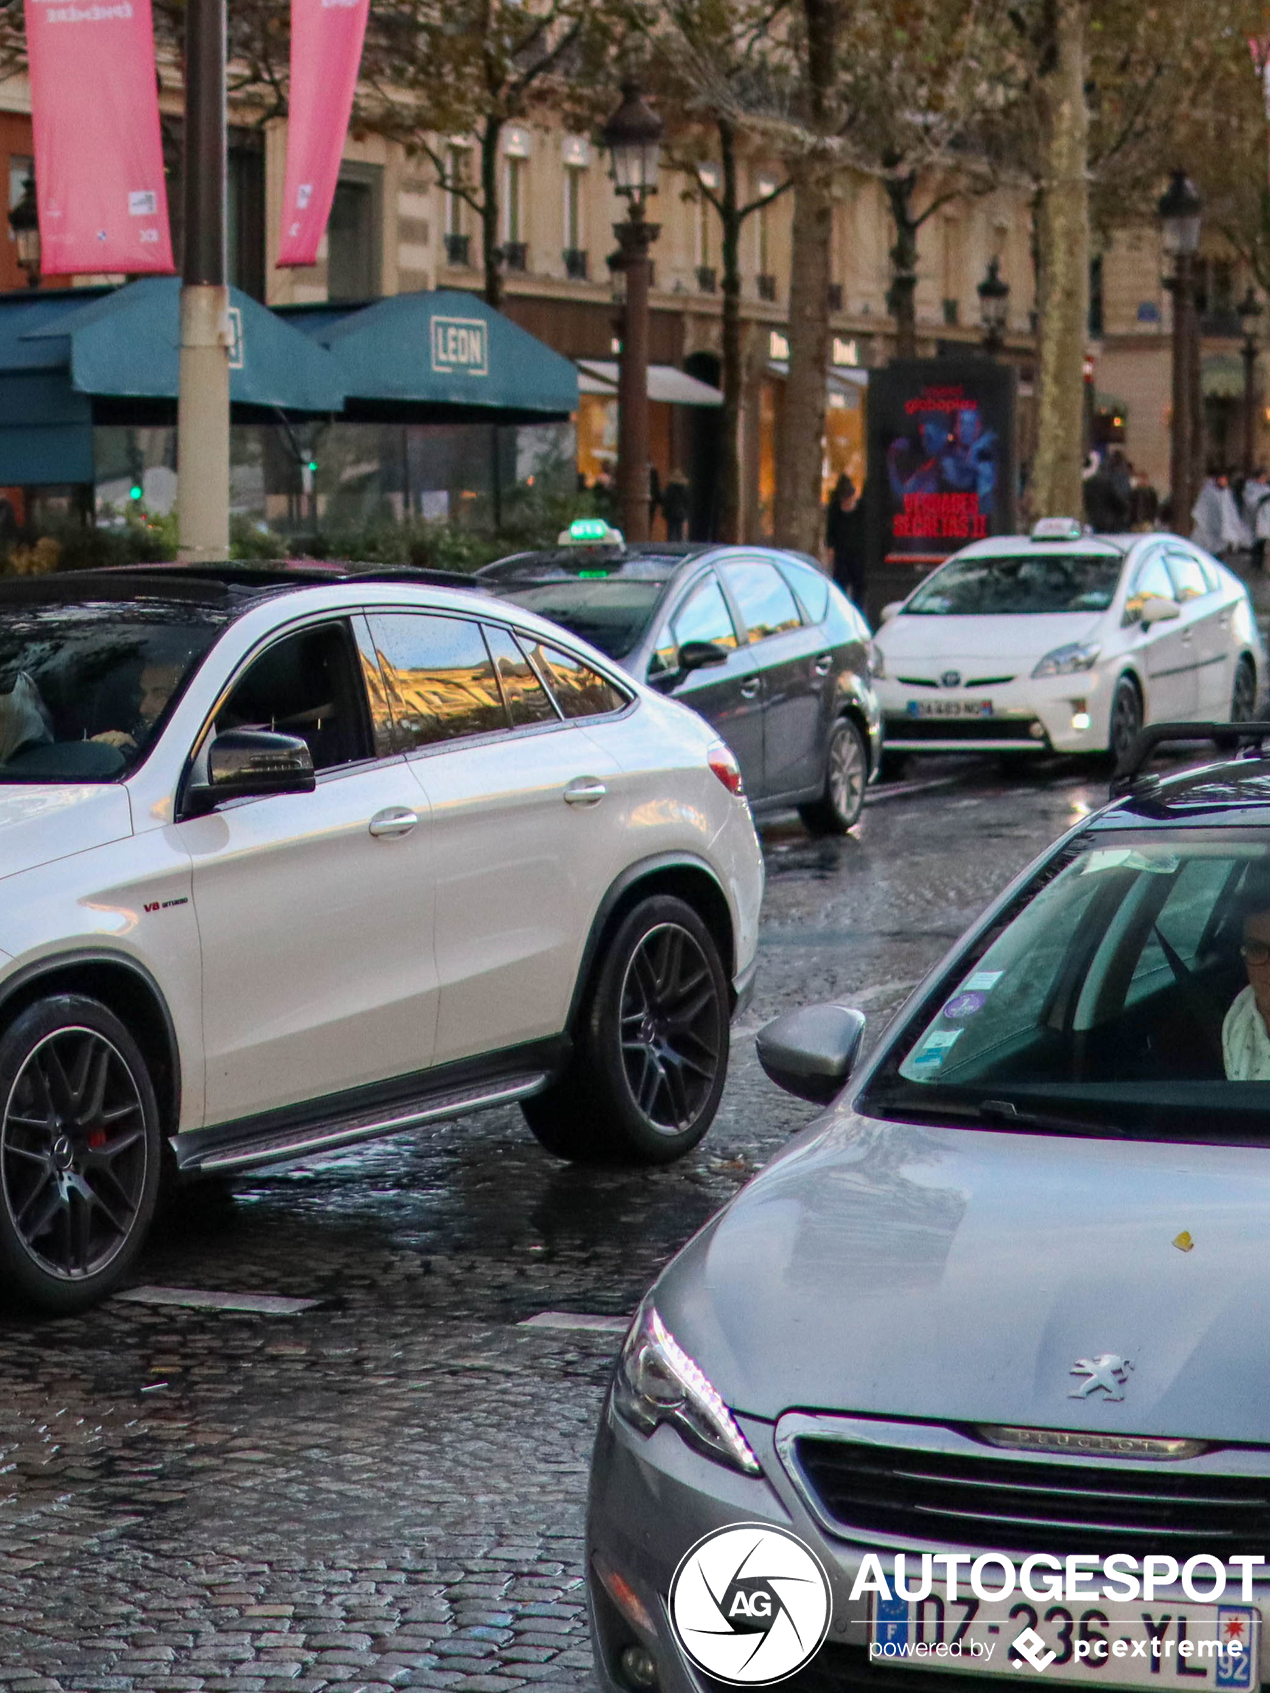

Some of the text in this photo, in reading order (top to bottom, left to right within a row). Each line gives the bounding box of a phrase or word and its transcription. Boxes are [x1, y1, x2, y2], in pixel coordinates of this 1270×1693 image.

[437, 327, 481, 363] LEON
[143, 901, 160, 912] V8
[1018, 1432, 1153, 1451] PEUGEOT
[1218, 1655, 1248, 1680] 92
